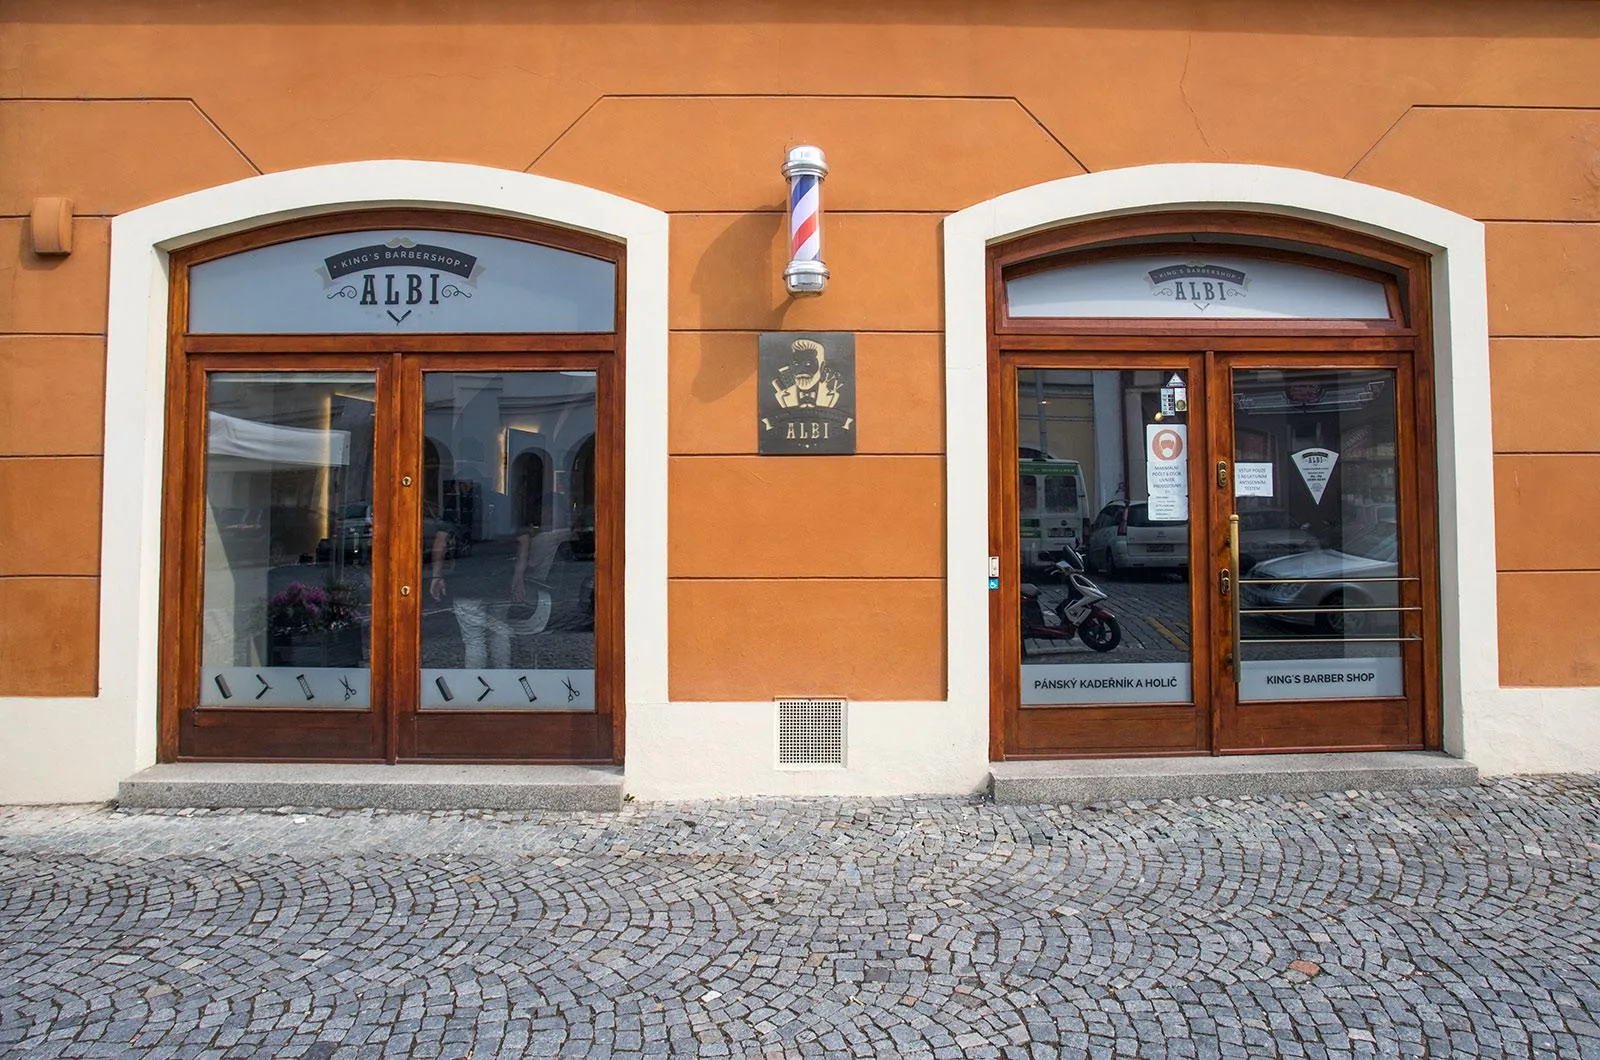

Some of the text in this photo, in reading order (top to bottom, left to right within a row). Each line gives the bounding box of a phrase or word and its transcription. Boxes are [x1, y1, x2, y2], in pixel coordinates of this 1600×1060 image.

[341, 250, 461, 268] KING'S BARBERSHOP
[1159, 268, 1237, 279] KING'S BARBERSHOP
[359, 273, 440, 305] ALBI
[1174, 281, 1227, 301] ALBI
[786, 422, 829, 439] ALBI
[1034, 675, 1178, 689] PÁNSKÝ KADEŘNÍK A HOLIČ
[1266, 672, 1375, 685] KING'S BARBER SHOP
